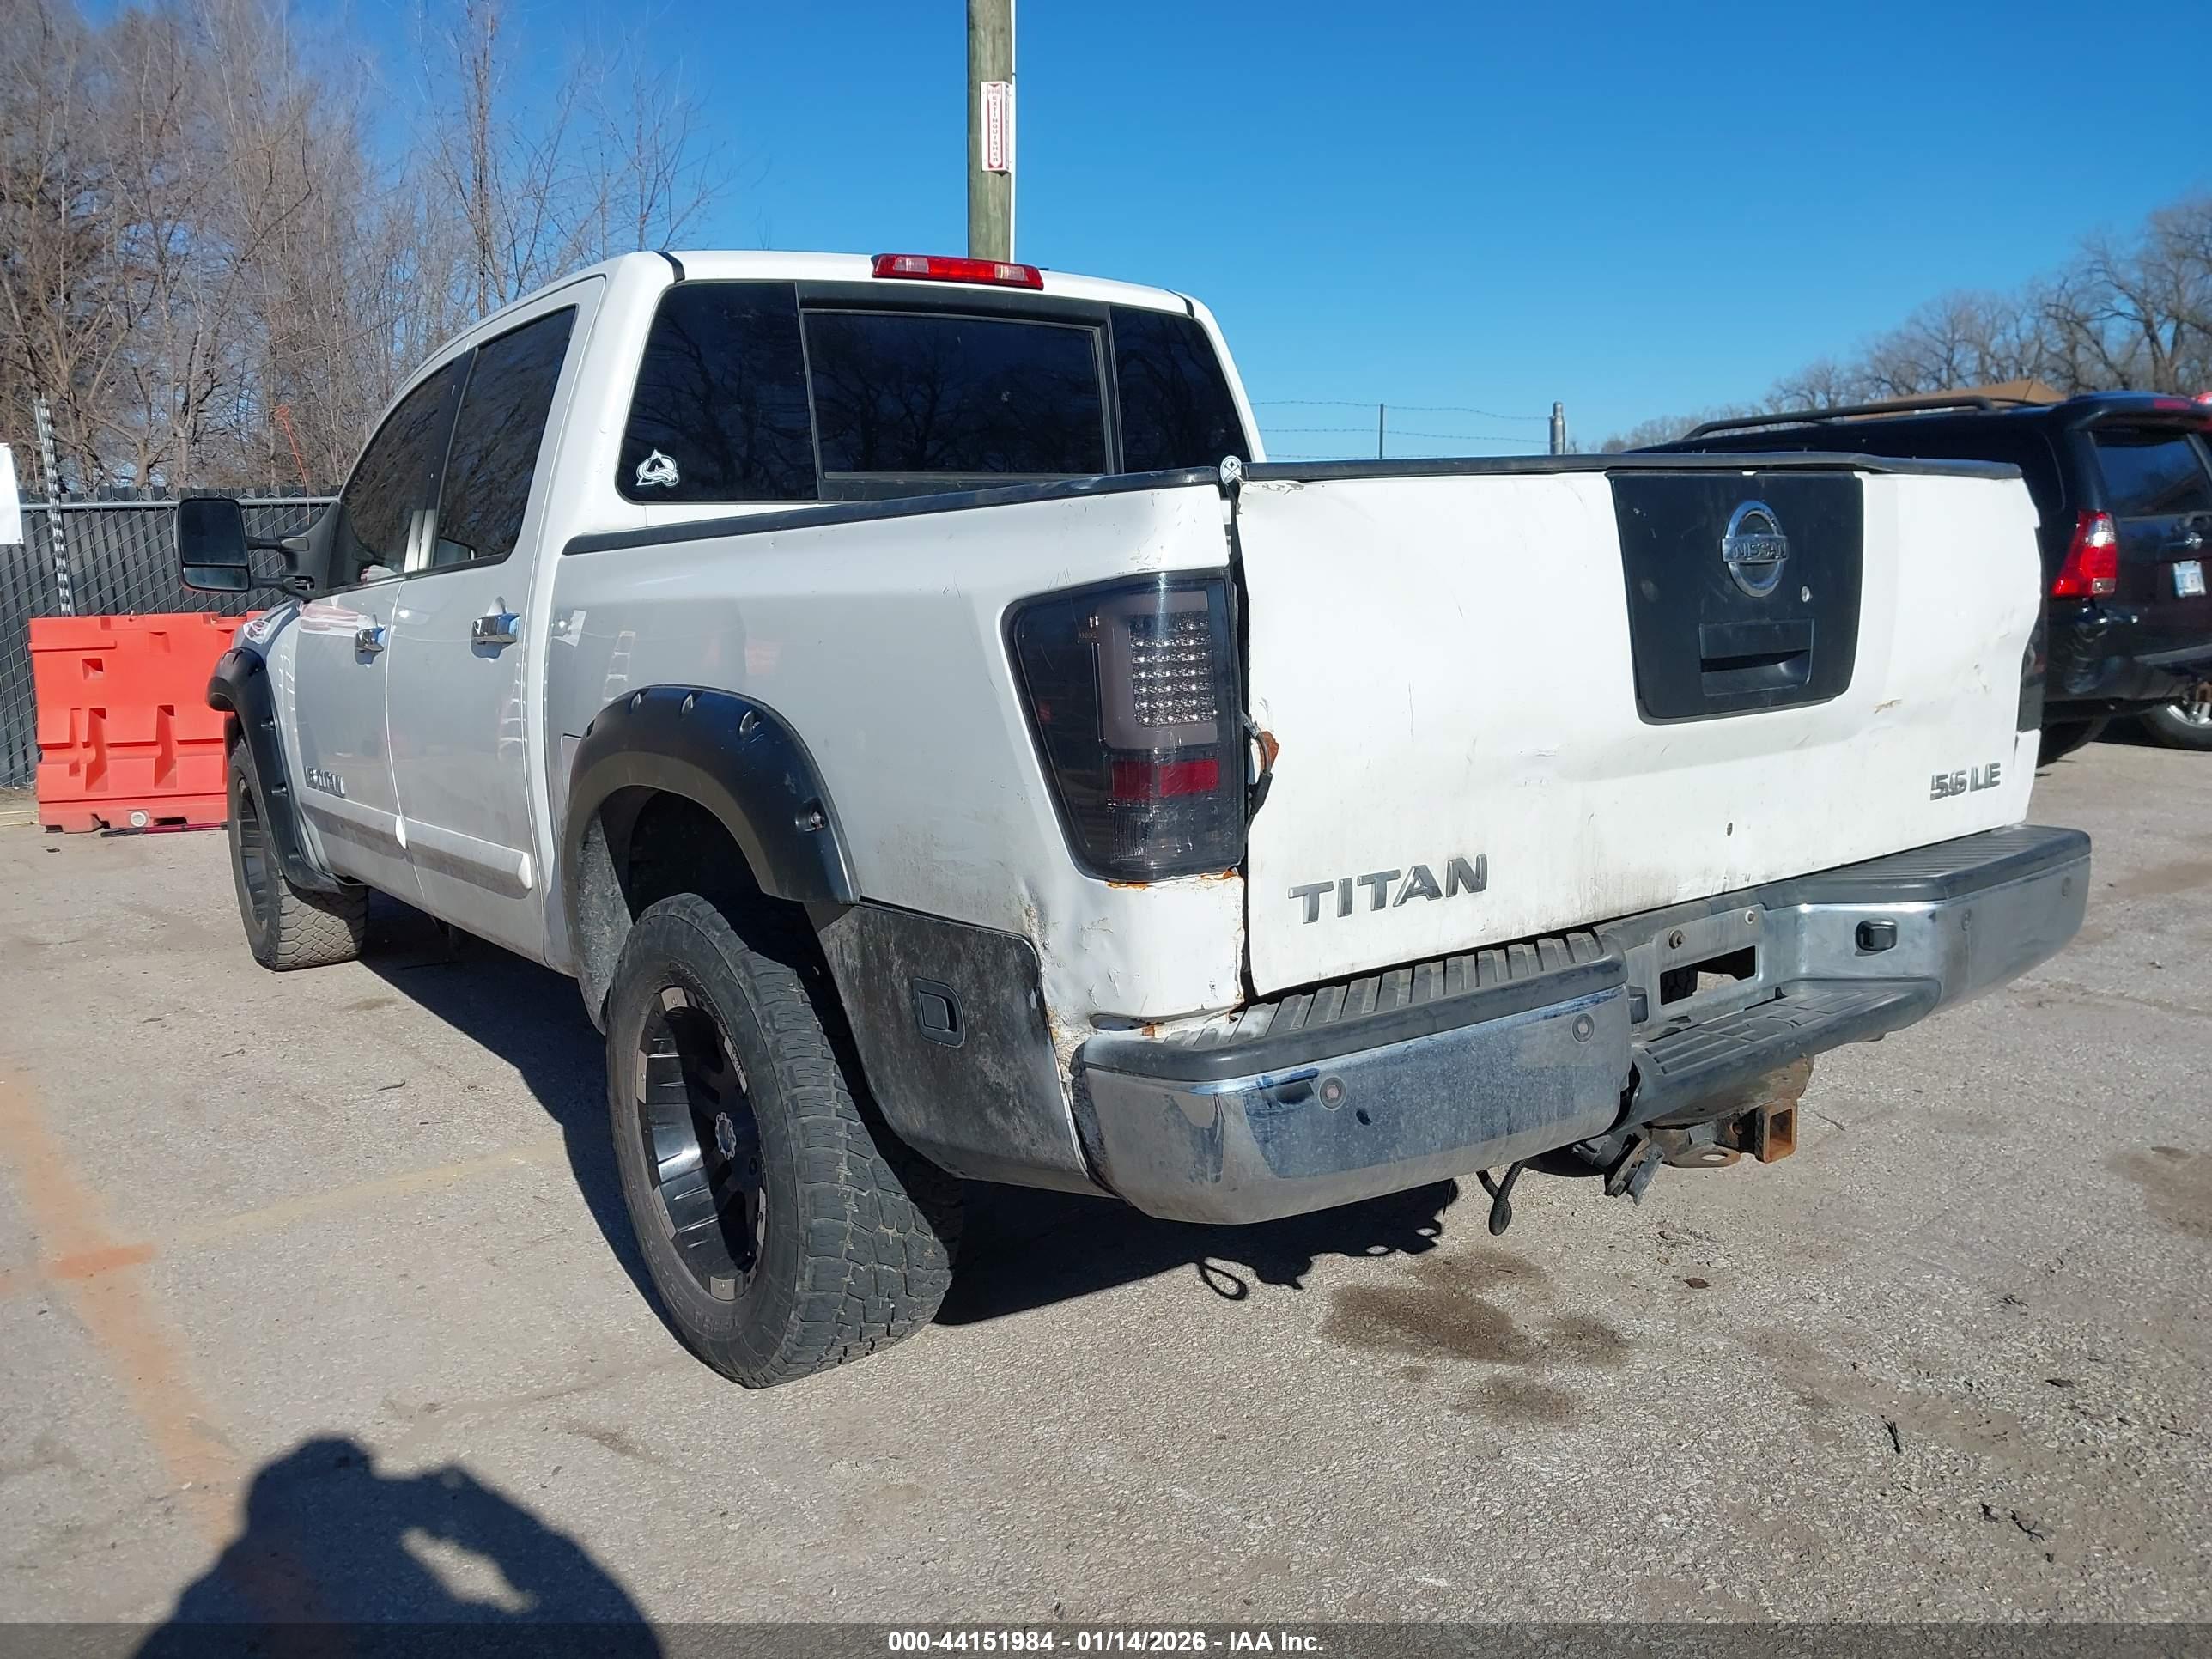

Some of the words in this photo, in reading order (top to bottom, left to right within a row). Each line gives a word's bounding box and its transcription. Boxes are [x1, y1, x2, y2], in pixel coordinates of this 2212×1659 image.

[1733, 541, 1787, 559] NISSAN
[1970, 763, 2001, 792] LE
[1288, 854, 1488, 925] TITAN
